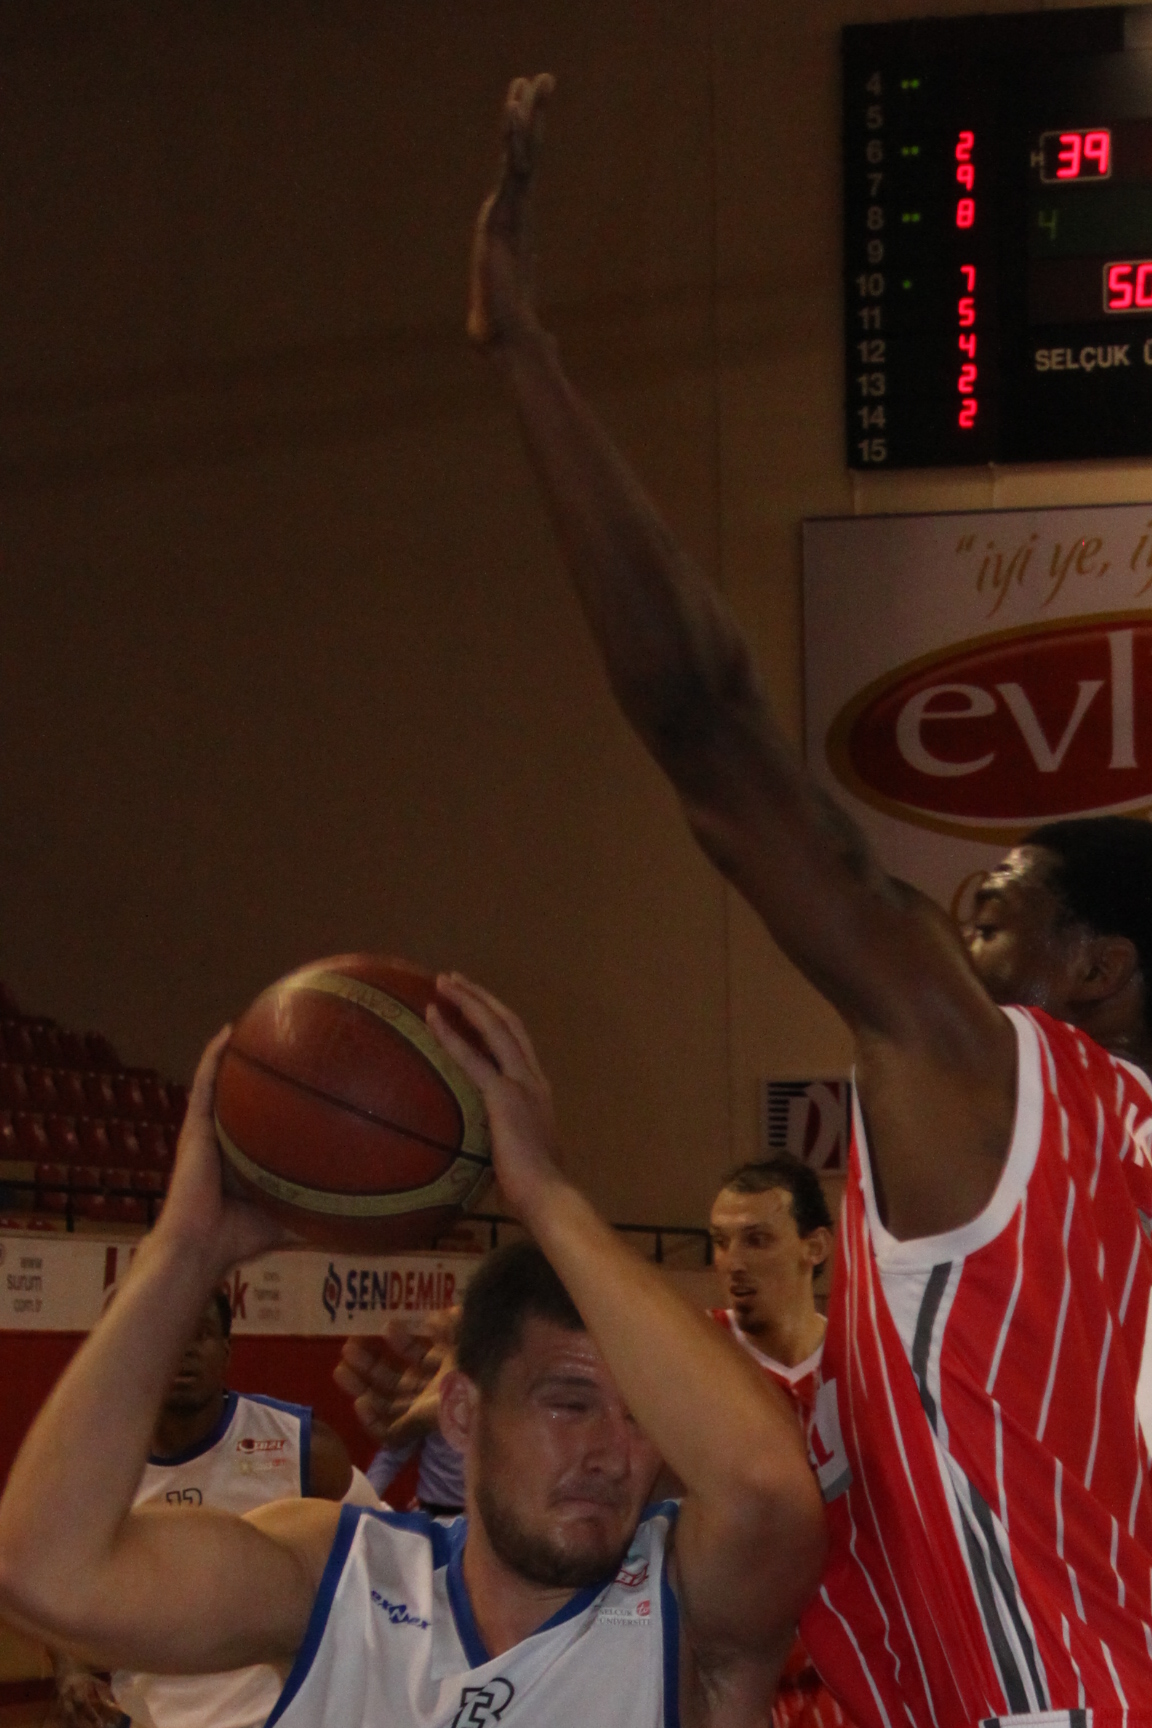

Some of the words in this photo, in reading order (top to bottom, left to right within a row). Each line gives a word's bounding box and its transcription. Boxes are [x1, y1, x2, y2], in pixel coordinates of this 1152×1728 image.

[865, 71, 883, 95] 4
[865, 104, 884, 129] 5
[865, 139, 884, 164] 6
[955, 129, 976, 161] 2
[1056, 131, 1110, 179] 39
[866, 172, 884, 197] 7
[956, 162, 976, 192] 9
[866, 205, 885, 231] 8
[956, 197, 976, 230] 8
[866, 239, 885, 264] 9
[855, 273, 885, 298] 10
[959, 262, 977, 293] 7
[857, 306, 882, 331] 11
[958, 296, 977, 328] 5
[856, 339, 886, 364] 12
[958, 331, 978, 360] 4
[1034, 344, 1131, 373] SELÇUK
[856, 372, 886, 397] 13
[958, 362, 978, 395] 2
[857, 406, 886, 430] 14
[958, 397, 979, 430] 2
[857, 438, 888, 463] 15
[346, 1263, 456, 1318] ŞENDEMİR
